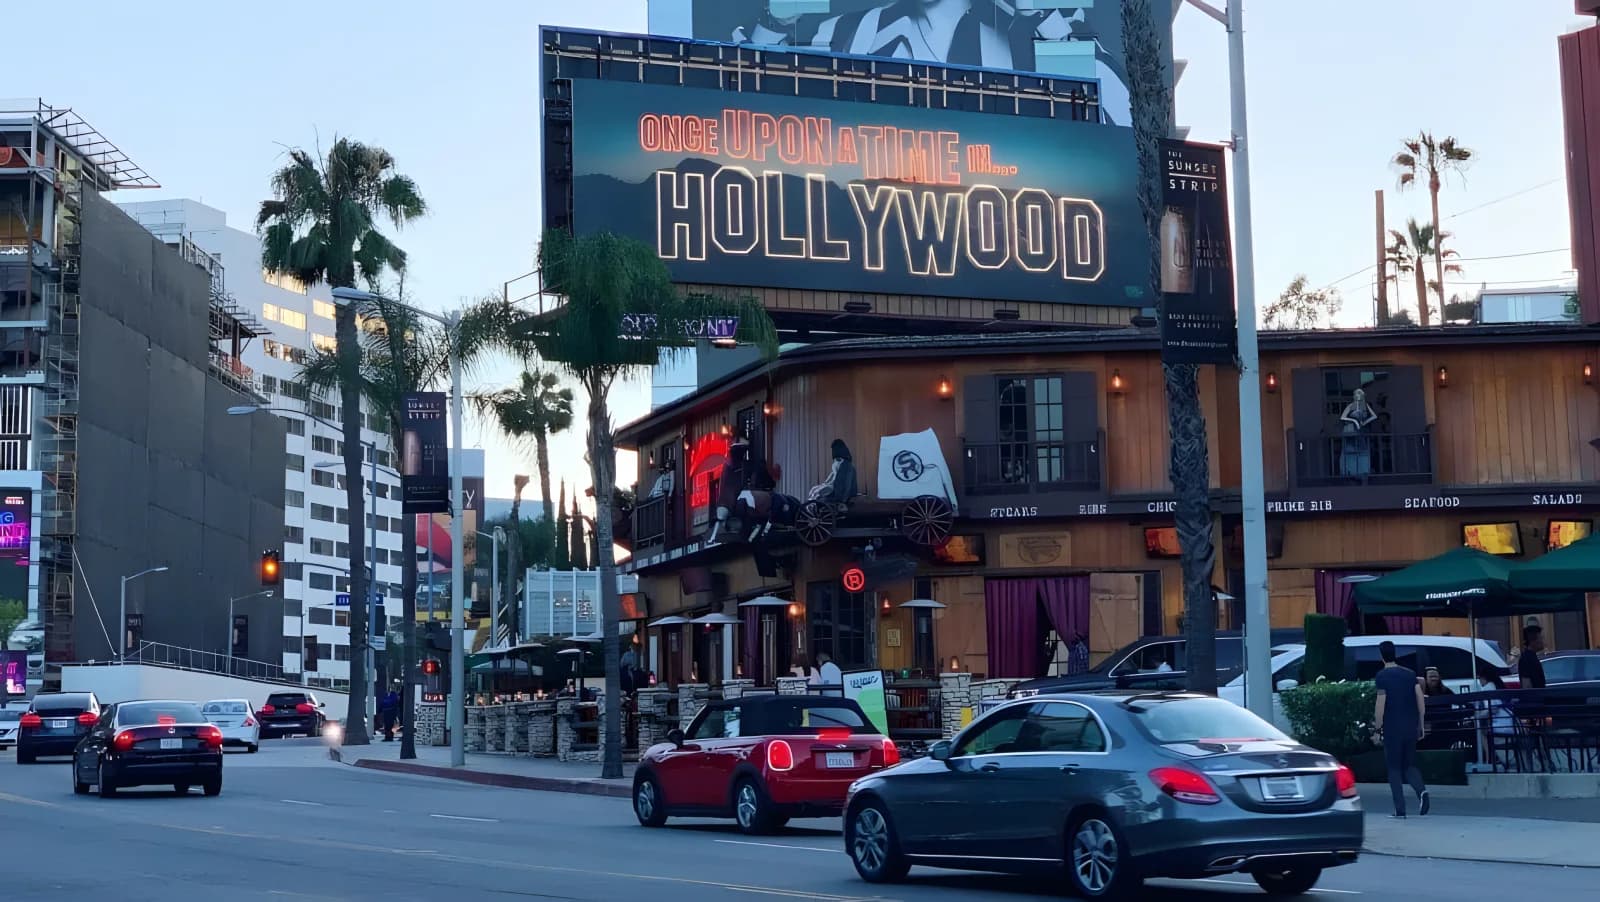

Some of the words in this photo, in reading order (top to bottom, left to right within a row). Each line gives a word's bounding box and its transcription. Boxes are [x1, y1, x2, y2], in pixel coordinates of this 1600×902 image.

[639, 113, 719, 156] ONCE
[723, 108, 833, 166] UPON
[837, 126, 858, 164] A
[858, 125, 961, 185] TIME
[1168, 160, 1217, 174] SUNSET
[1169, 179, 1218, 192] STRIP
[656, 165, 1106, 283] HOLLYWOOD
[1404, 497, 1460, 508] SEAFOOD
